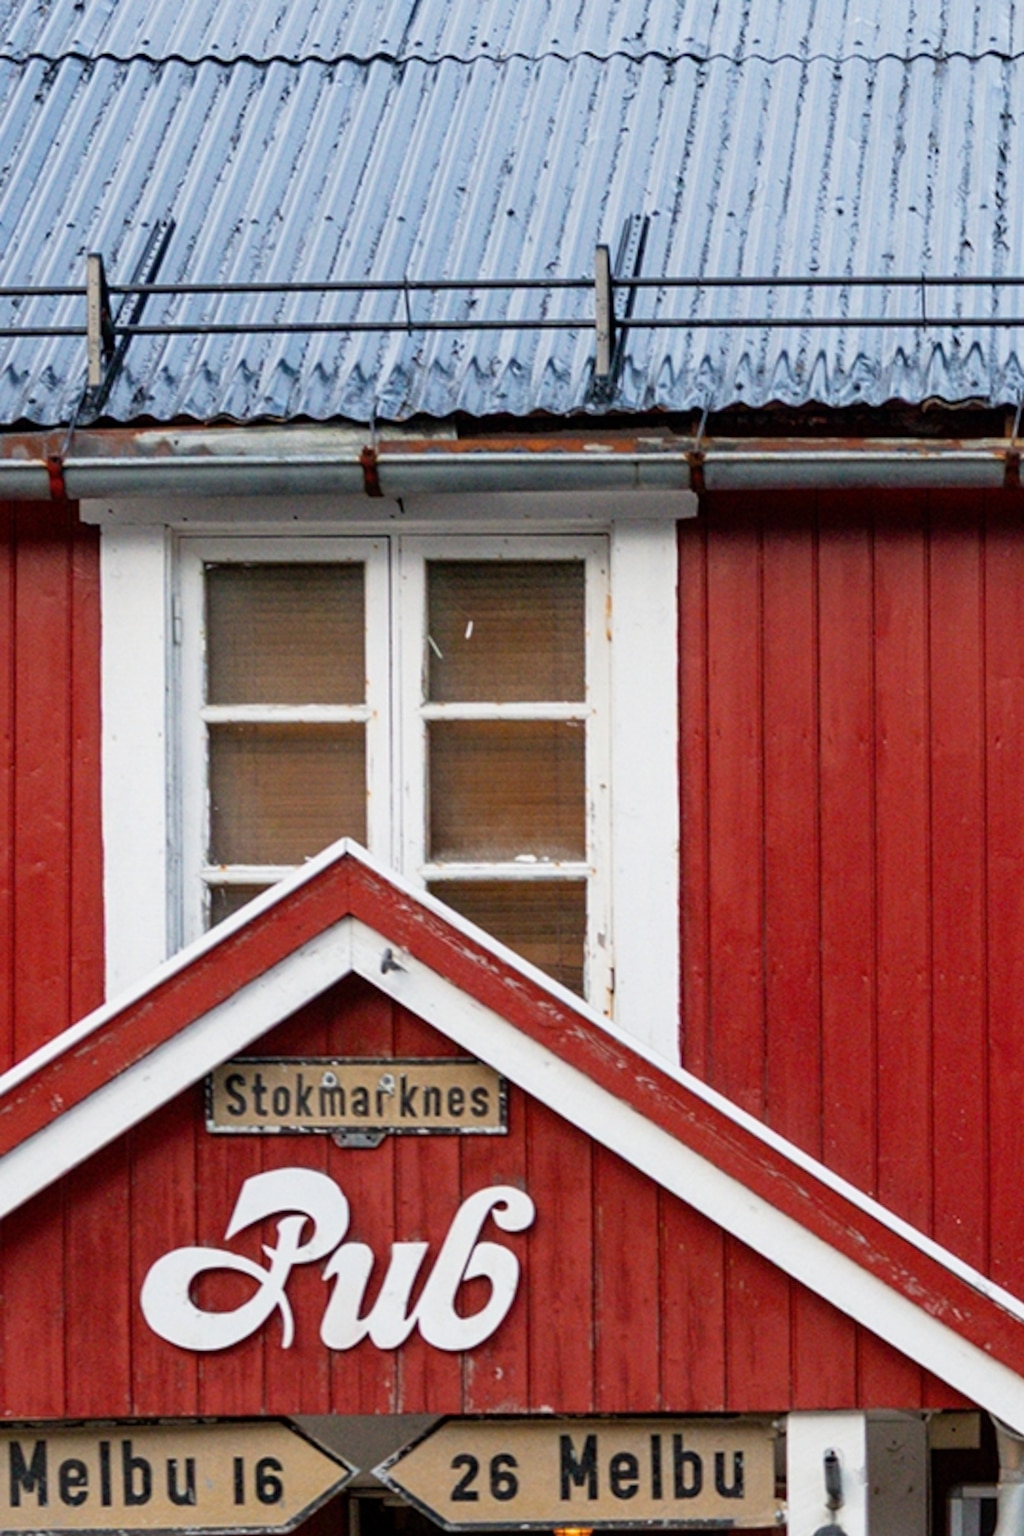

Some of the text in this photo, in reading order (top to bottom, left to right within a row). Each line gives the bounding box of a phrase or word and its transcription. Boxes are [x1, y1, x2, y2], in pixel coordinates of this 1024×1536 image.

[226, 1072, 490, 1119] Stokmarknes
[141, 1167, 536, 1351] Pub
[9, 1440, 285, 1506] Melbu 16
[451, 1434, 745, 1501] 26 Melbu
